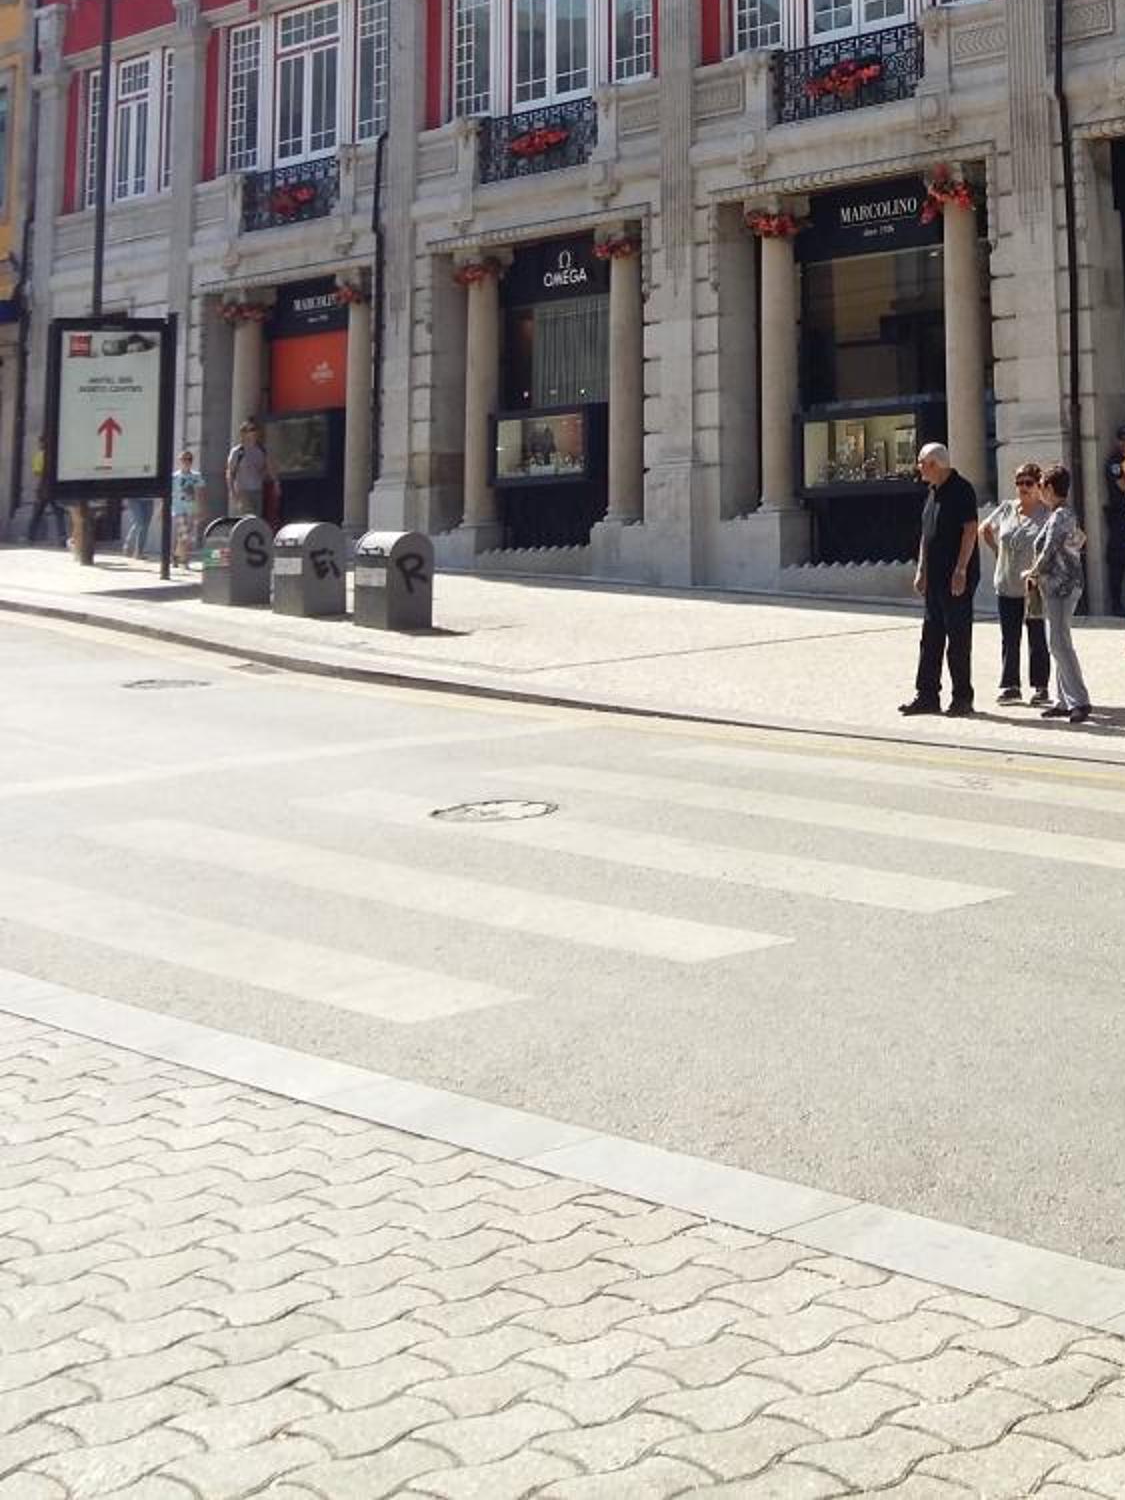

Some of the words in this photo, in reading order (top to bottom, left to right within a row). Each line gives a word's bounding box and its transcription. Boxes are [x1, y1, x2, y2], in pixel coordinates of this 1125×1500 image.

[841, 197, 917, 223] MARCOLINO
[543, 267, 587, 287] OMEGA
[396, 553, 428, 594] R
